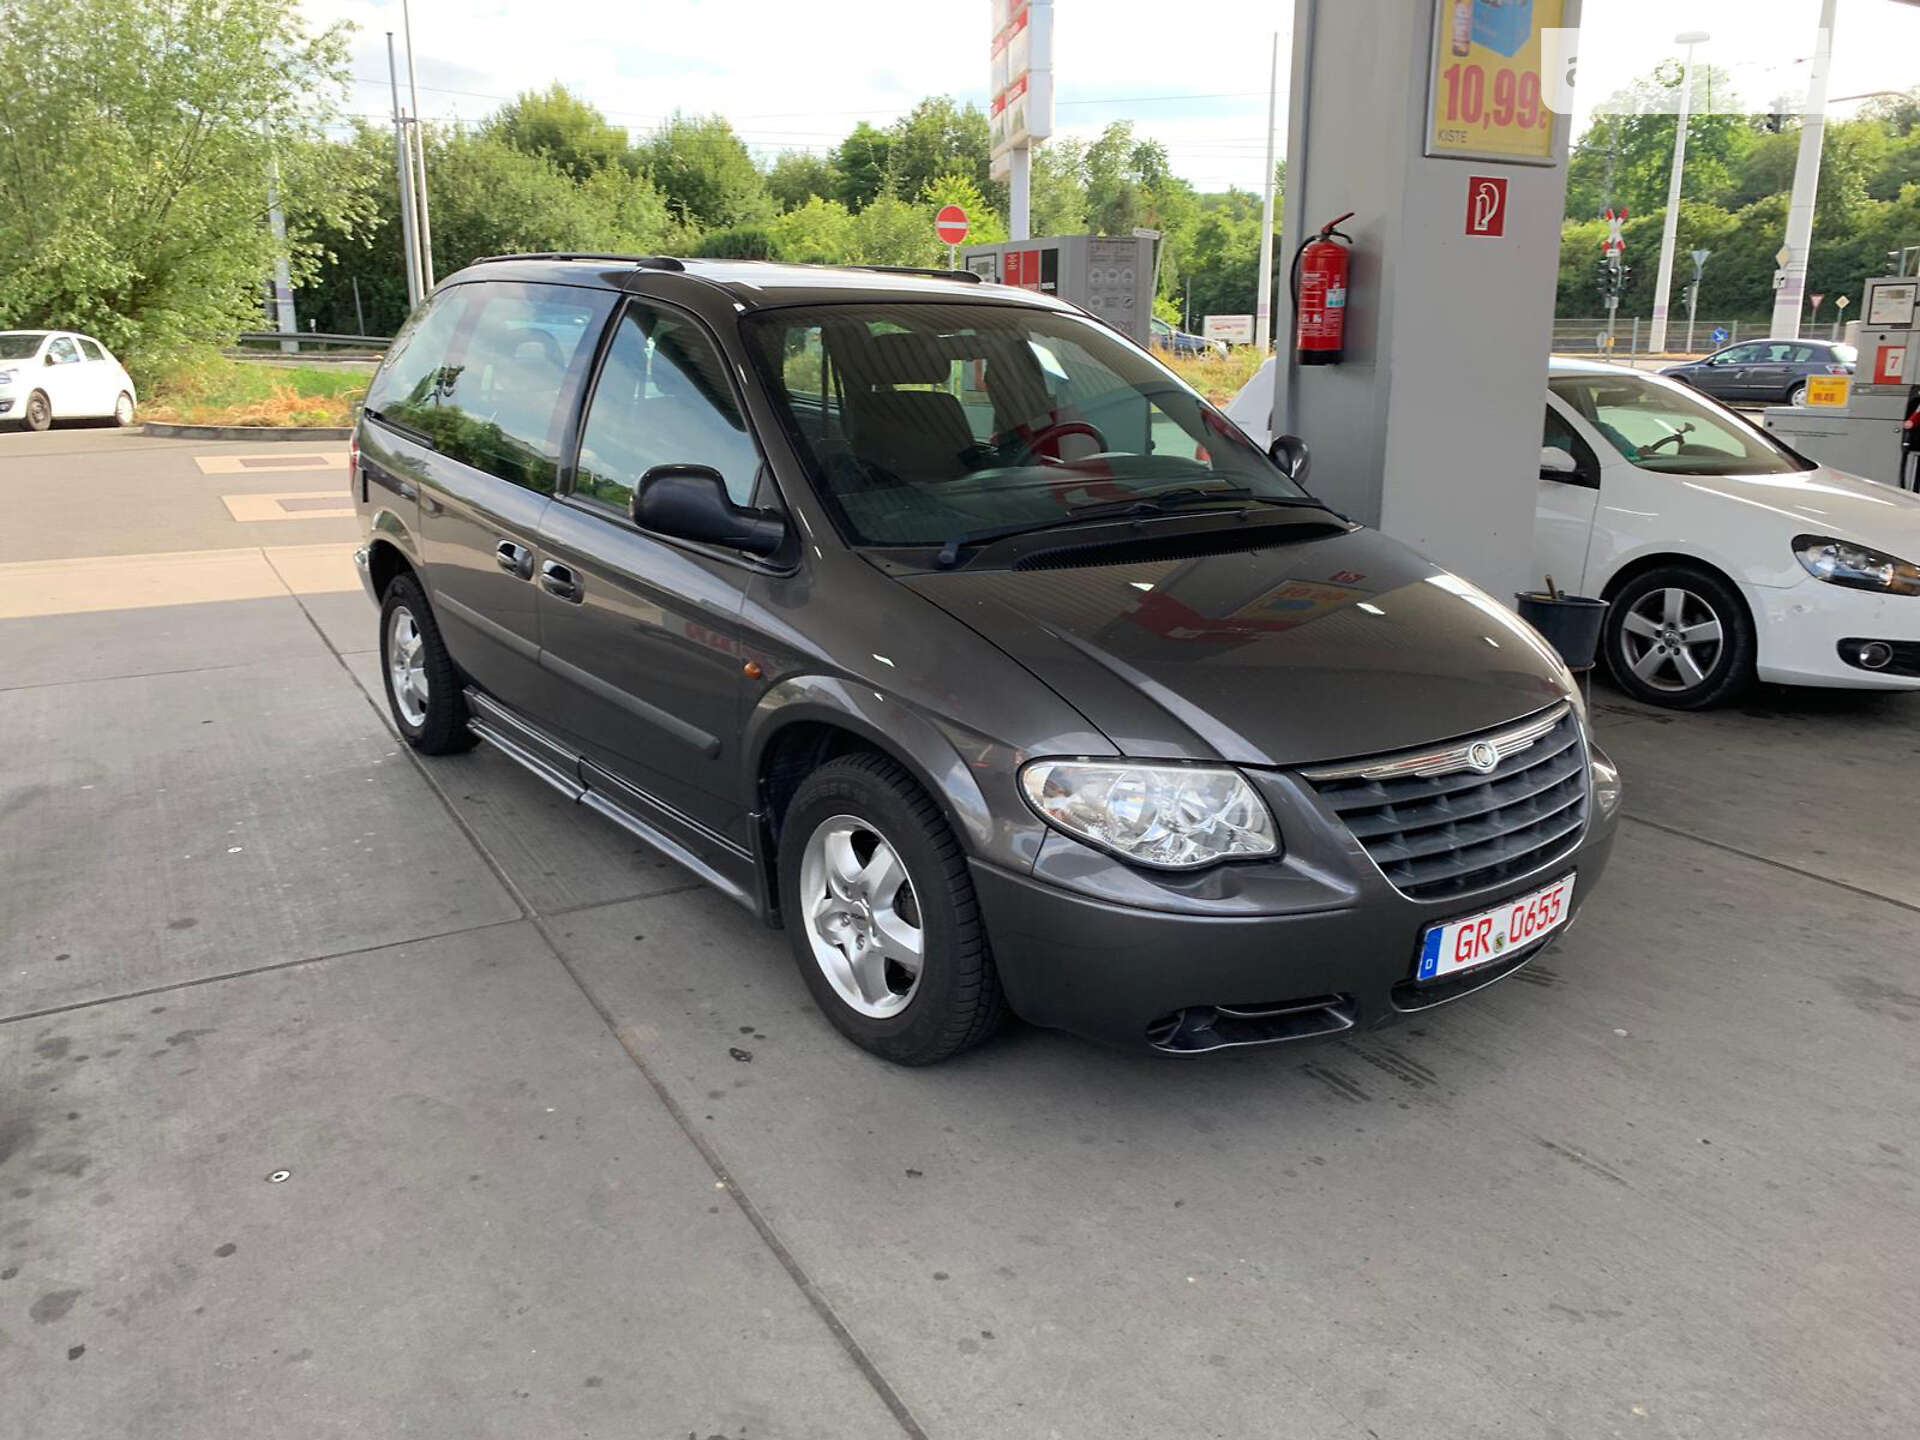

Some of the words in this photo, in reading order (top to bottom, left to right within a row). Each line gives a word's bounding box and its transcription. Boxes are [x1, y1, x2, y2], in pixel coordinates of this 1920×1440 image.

[1438, 128, 1468, 144] KISTE
[1890, 355, 1900, 370] 7
[1454, 917, 1494, 963] GR
[1509, 886, 1565, 943] 0655
[1424, 957, 1433, 970] D
